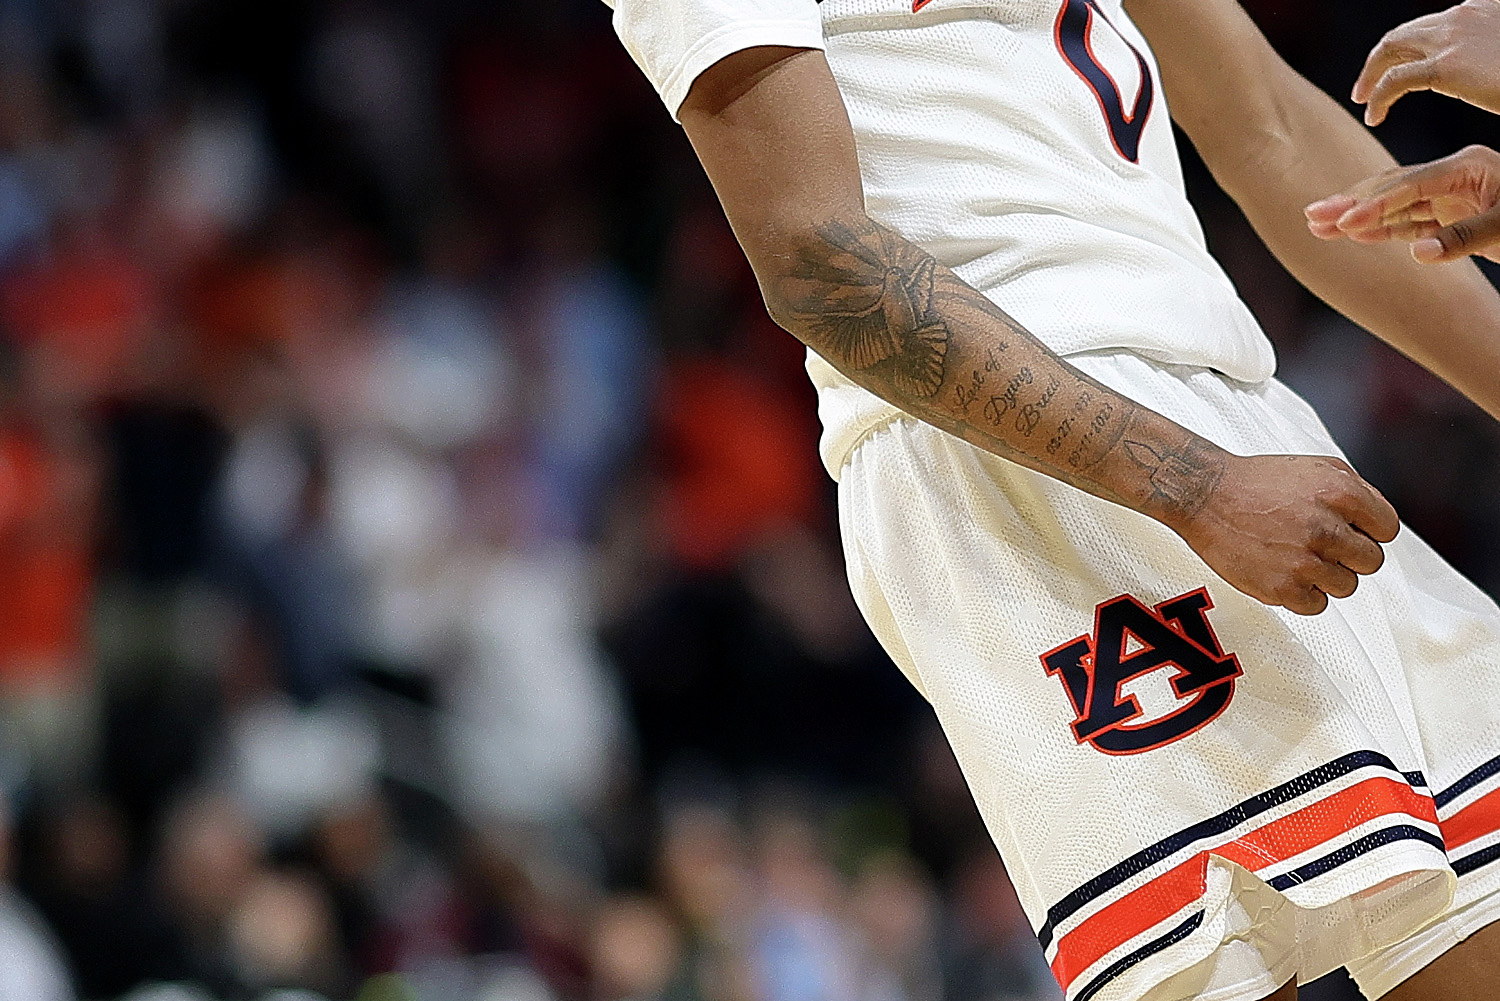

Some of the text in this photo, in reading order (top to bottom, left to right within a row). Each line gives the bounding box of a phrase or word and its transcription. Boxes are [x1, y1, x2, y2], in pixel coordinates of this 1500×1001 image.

[953, 369, 986, 413] Last
[984, 348, 1001, 373] of
[984, 366, 1034, 427] Dying
[1015, 374, 1061, 438] Breed
